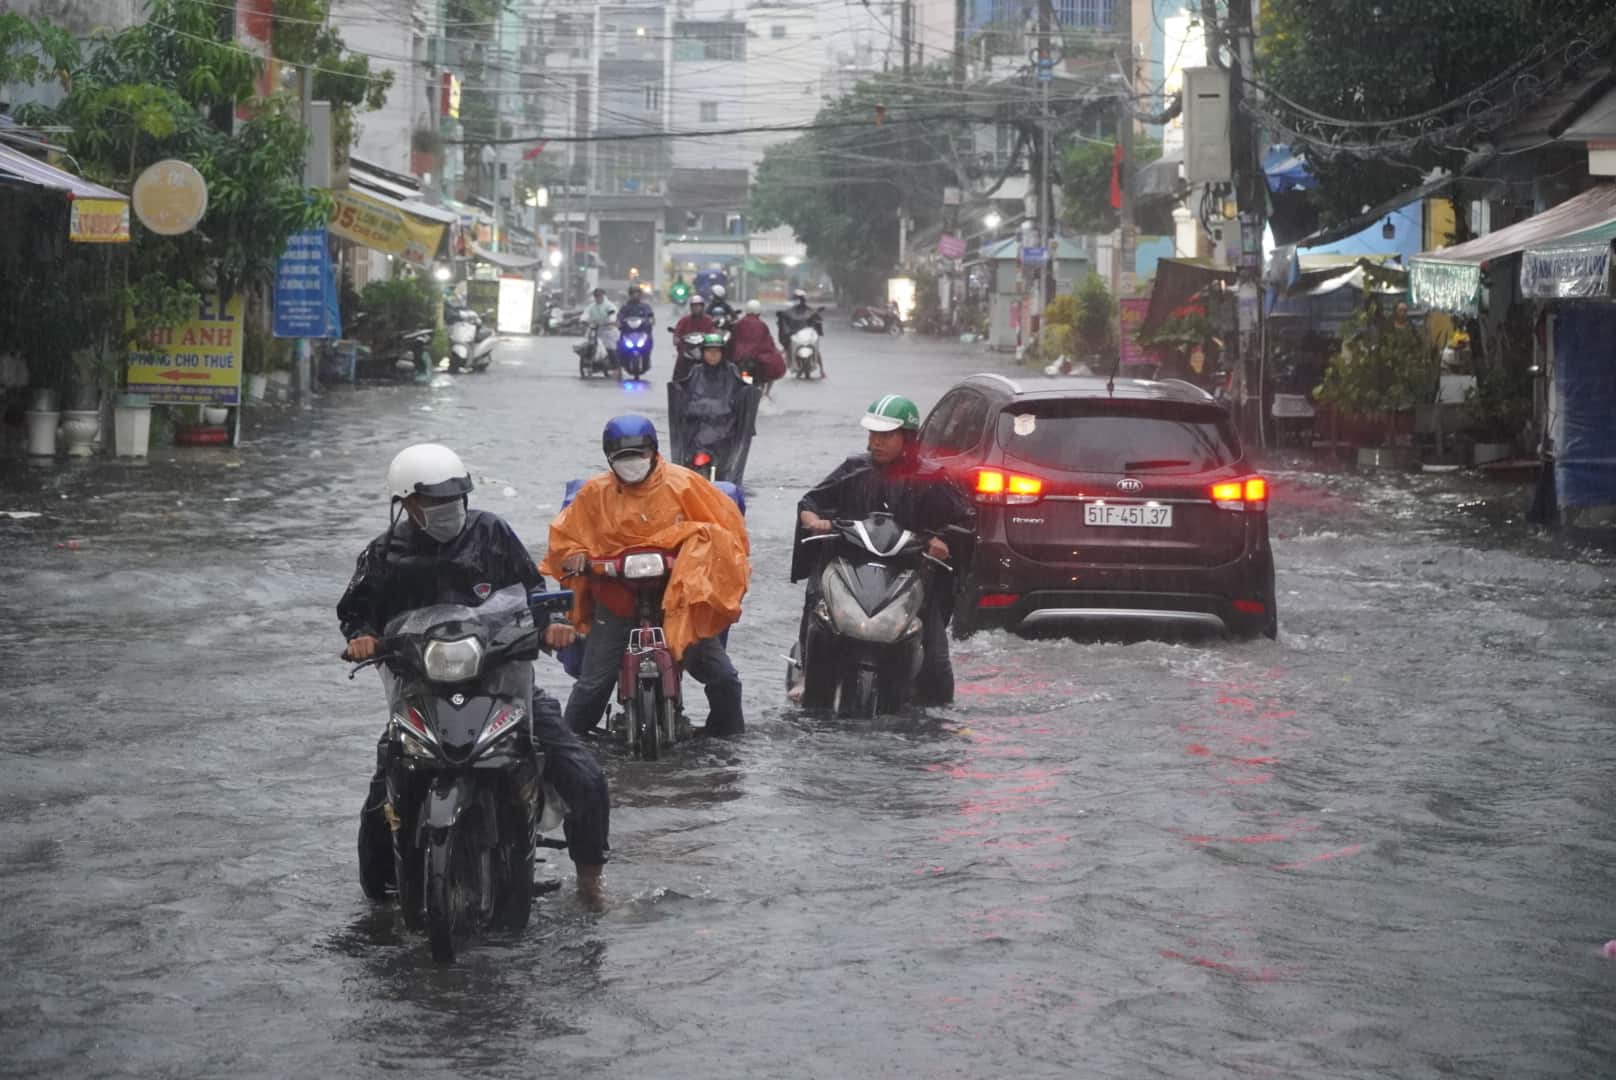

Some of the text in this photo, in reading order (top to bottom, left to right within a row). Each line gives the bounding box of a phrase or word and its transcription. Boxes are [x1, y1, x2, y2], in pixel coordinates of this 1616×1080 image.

[181, 327, 233, 346] ANH
[175, 354, 199, 368] CHO
[1088, 507, 1168, 524] 51F-451.37
